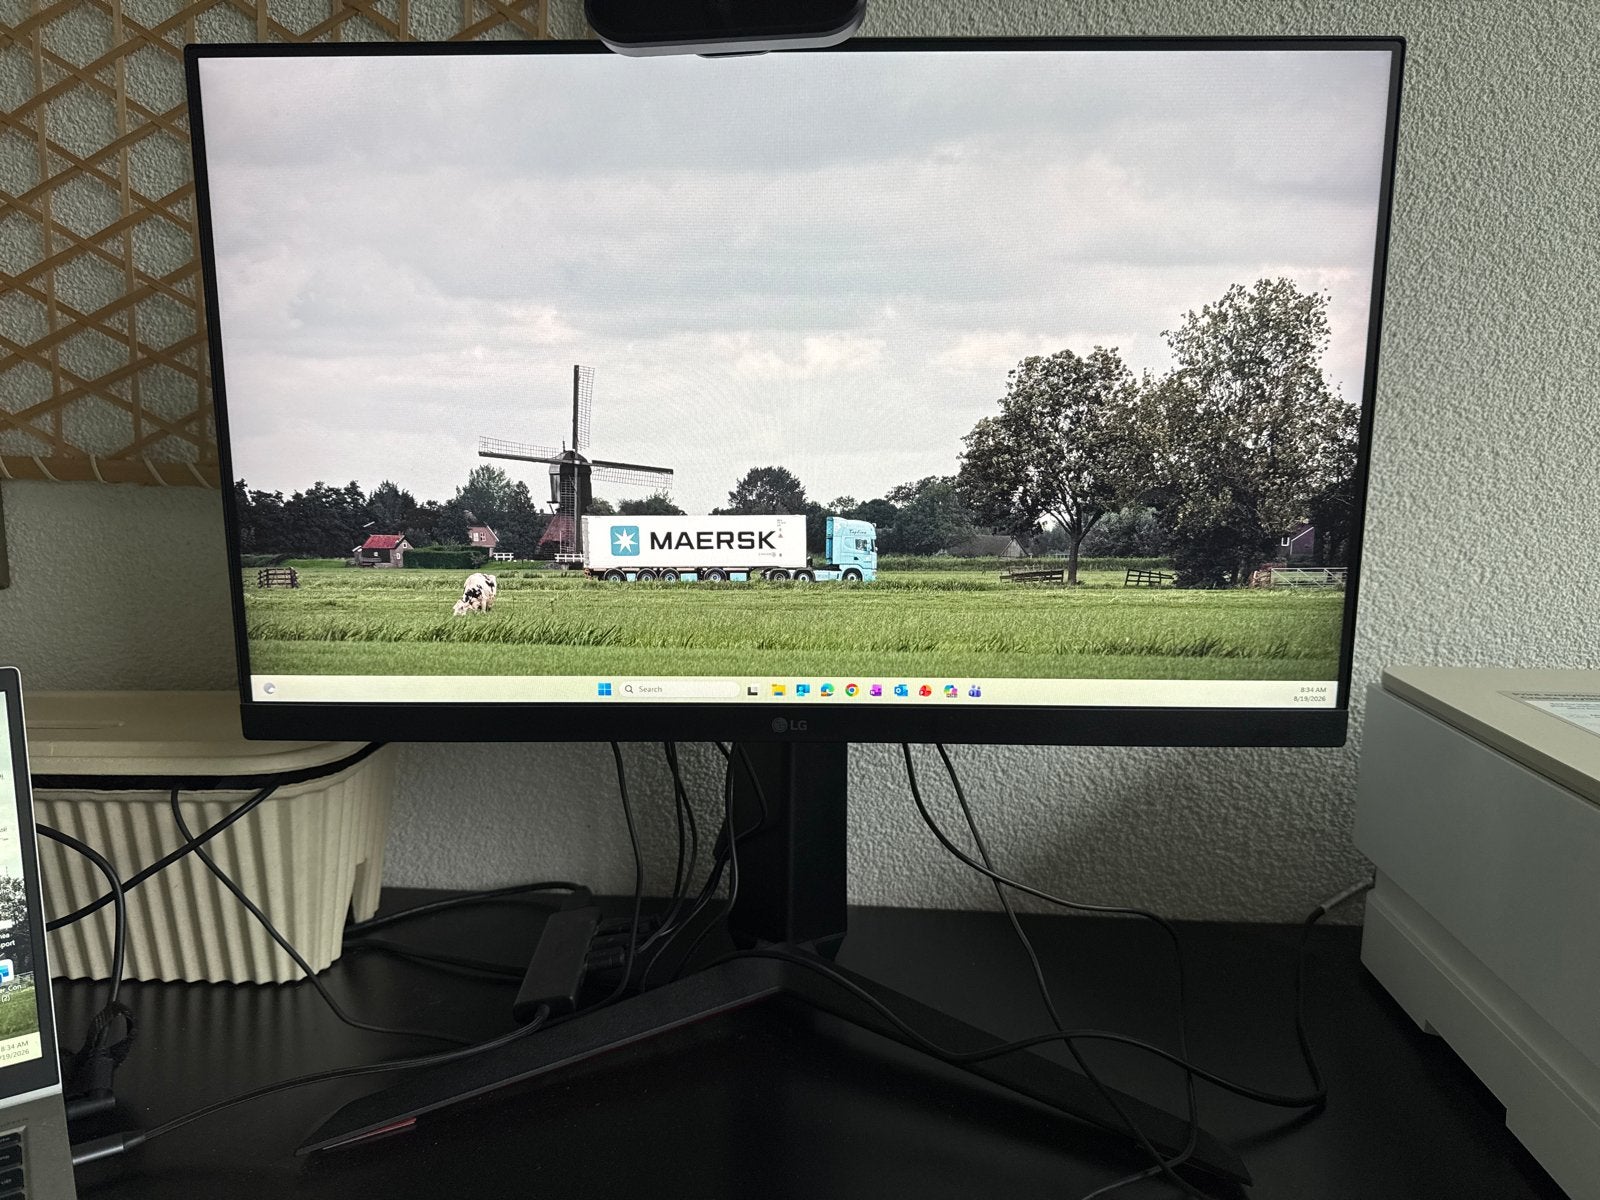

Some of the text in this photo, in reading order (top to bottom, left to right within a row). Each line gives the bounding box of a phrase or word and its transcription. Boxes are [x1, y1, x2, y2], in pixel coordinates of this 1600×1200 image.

[650, 530, 776, 550] MAERSK
[639, 685, 663, 693] Search
[790, 719, 808, 731] LG
[0, 939, 16, 950] port
[16, 1040, 29, 1049] AM
